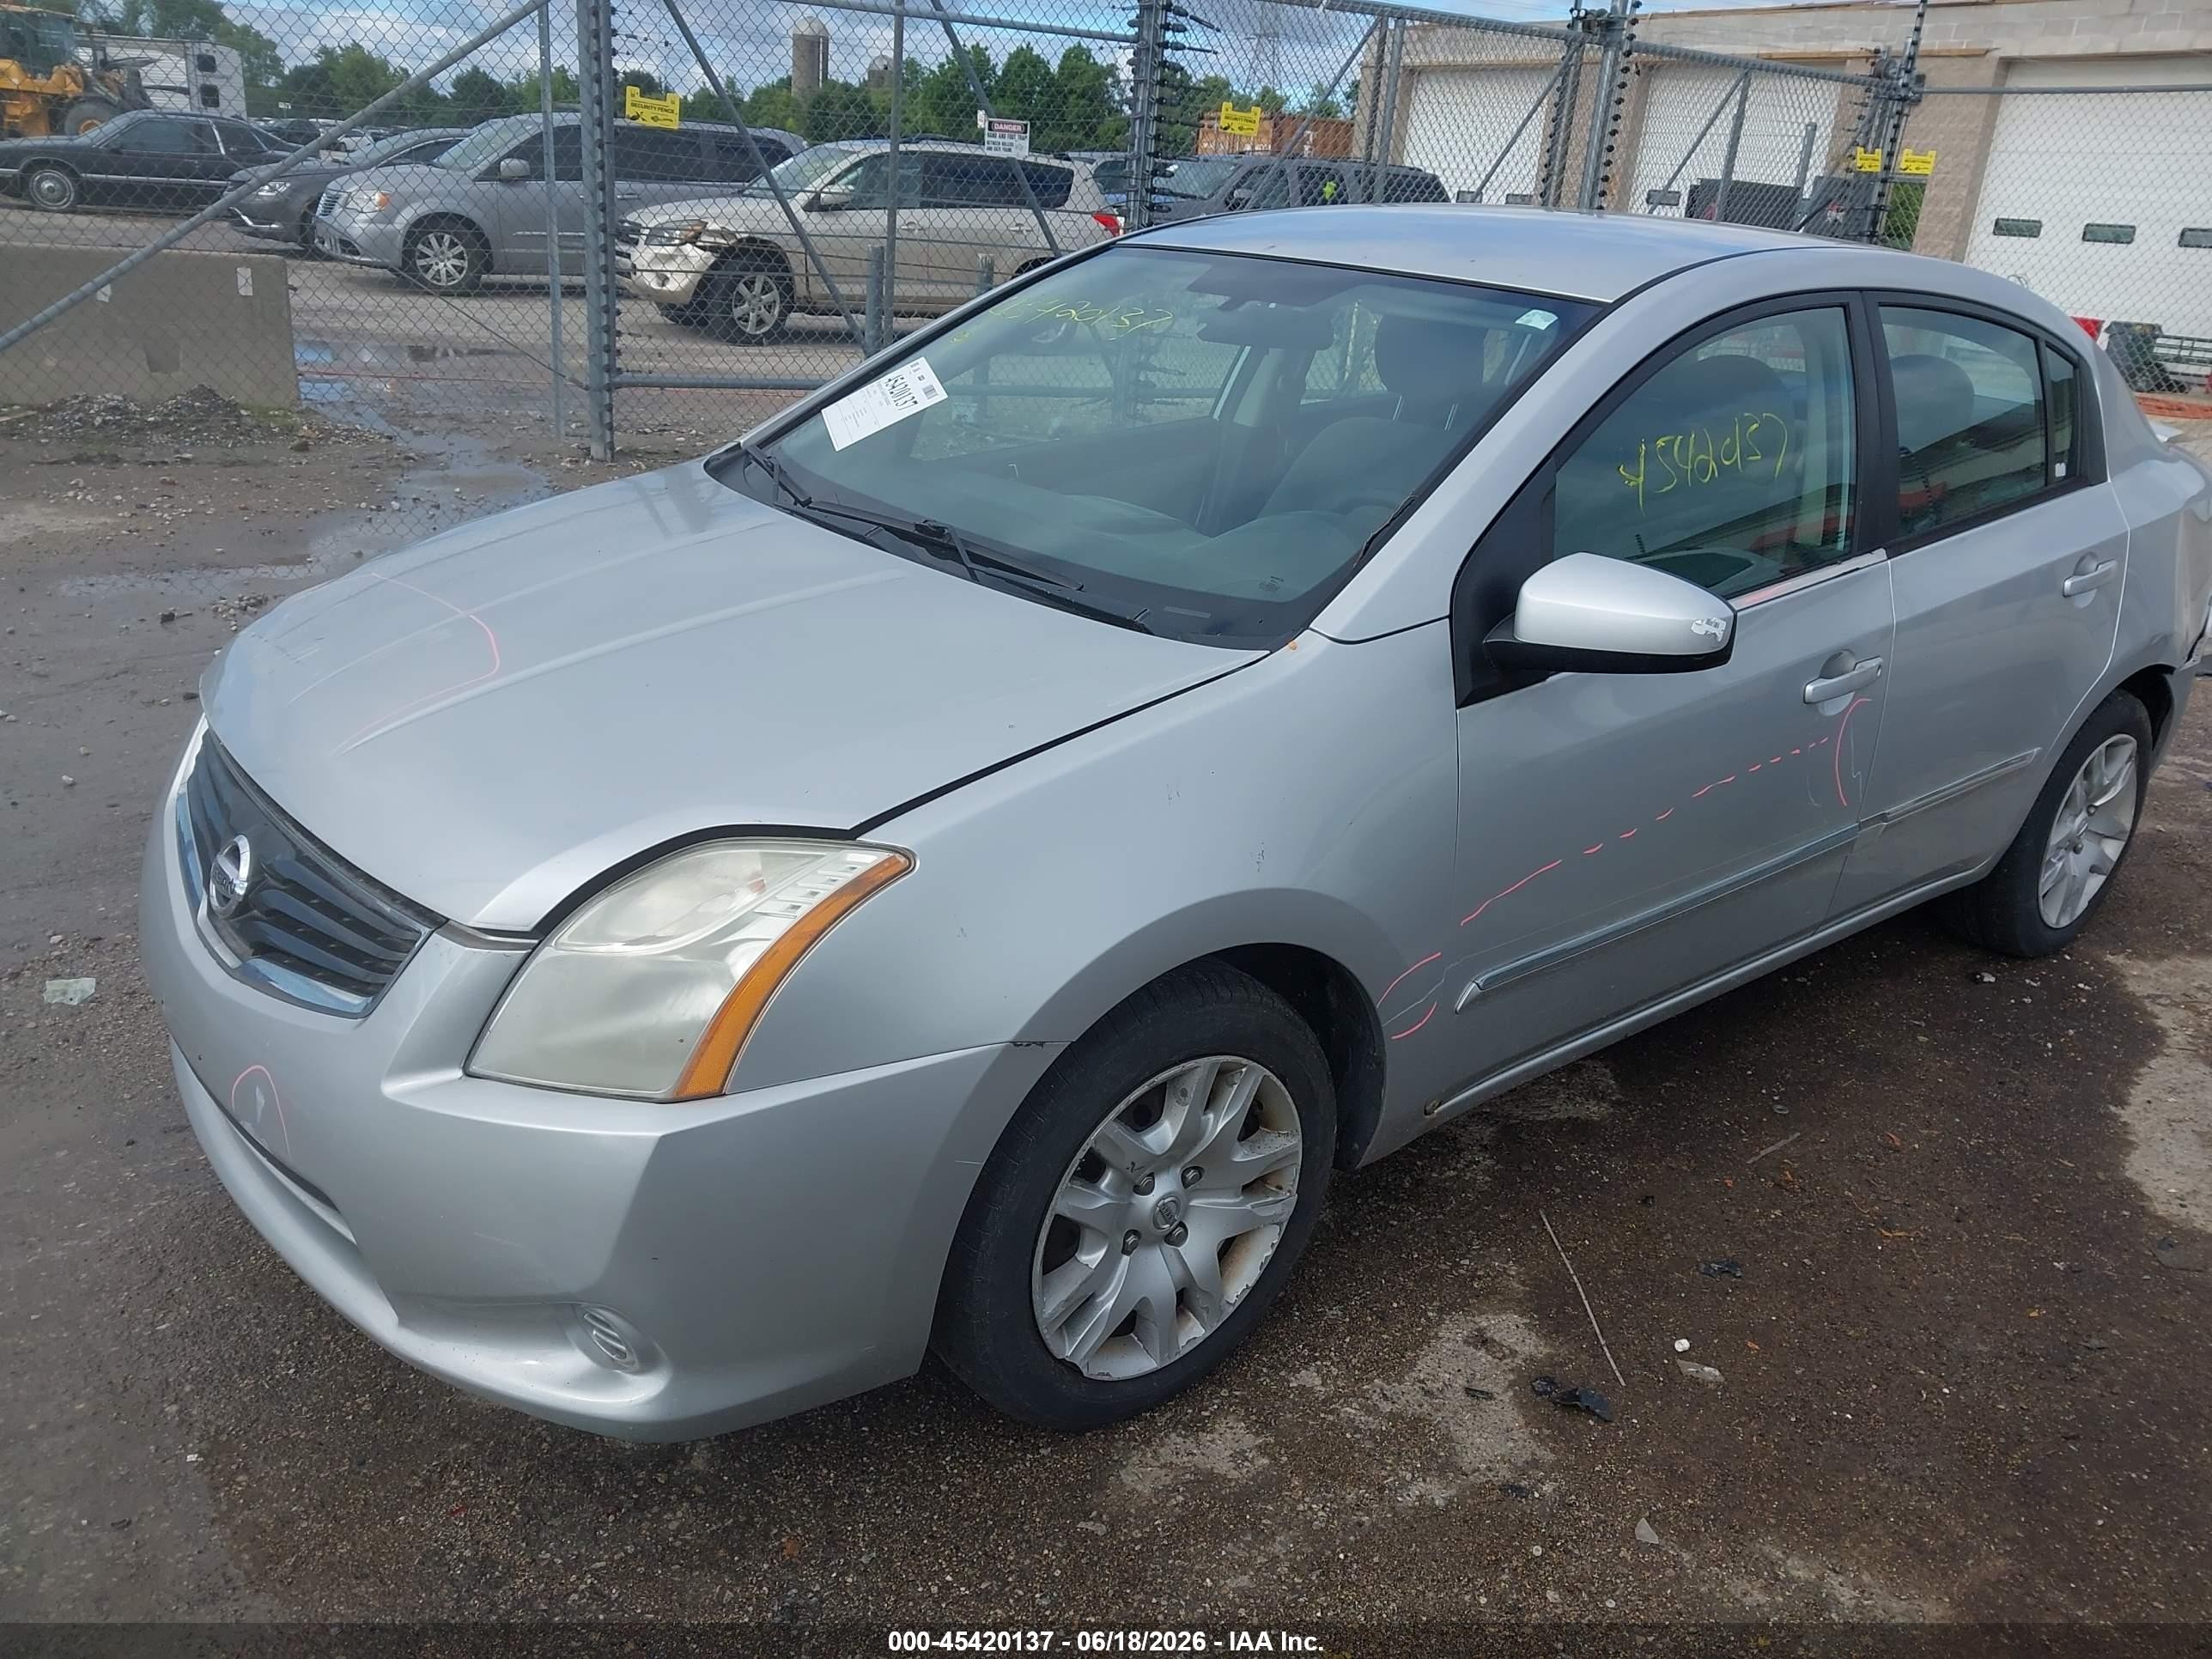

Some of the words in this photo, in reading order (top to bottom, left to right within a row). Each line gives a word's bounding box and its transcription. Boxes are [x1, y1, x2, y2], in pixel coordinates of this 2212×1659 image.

[630, 102, 656, 111] SECURITY
[994, 123, 1022, 131] DANGER
[884, 374, 919, 411] 45420137
